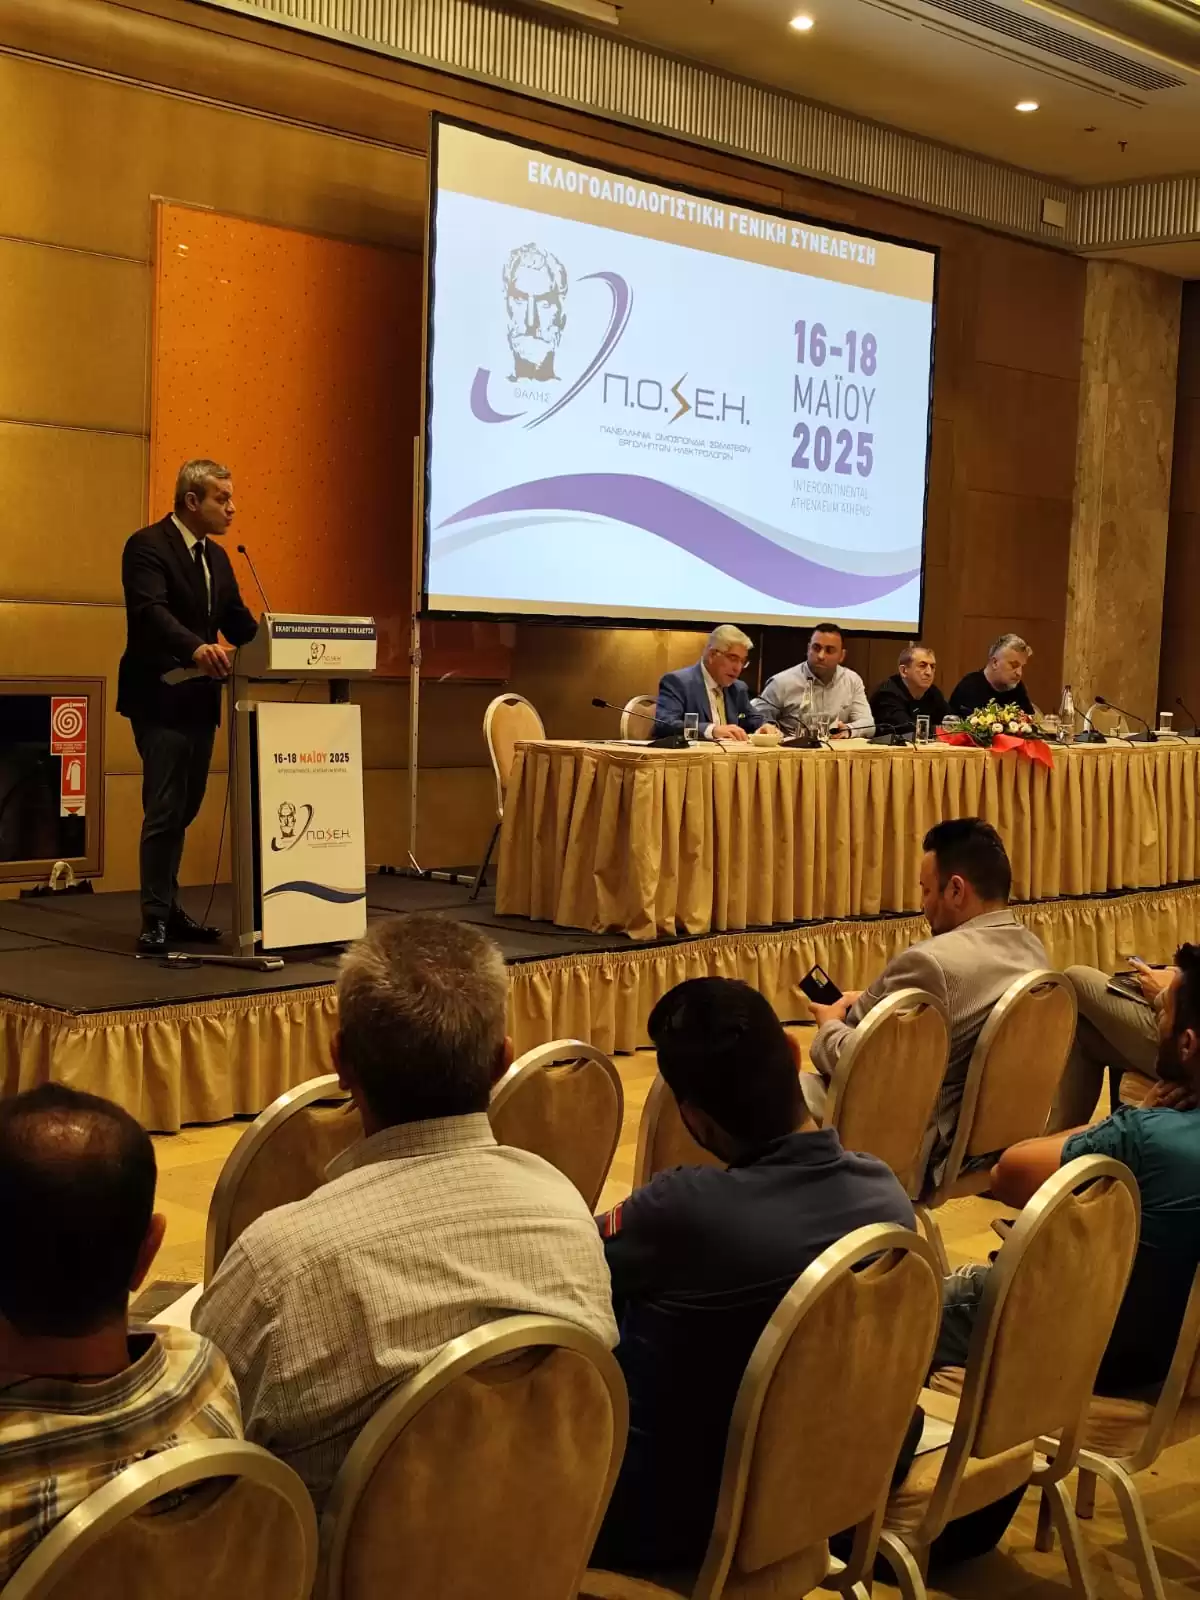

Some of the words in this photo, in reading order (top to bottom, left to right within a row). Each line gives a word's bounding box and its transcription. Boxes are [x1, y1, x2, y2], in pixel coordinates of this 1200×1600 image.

[527, 160, 725, 231] ΕΚΛΟΓΟΑΠΟΛΟΓΙΣΤΙΚΗ
[728, 212, 787, 245] ΓΕΝΙΚΗ
[790, 228, 876, 266] ΣΥΝΕΛΕΥΣΗ
[794, 319, 878, 377] 16-18
[513, 387, 552, 404] ΘΑΛΗΣ
[793, 374, 876, 425] ΜΑΪΟΥ
[791, 421, 874, 478] 2025
[274, 753, 297, 764] 16-18
[329, 752, 350, 763] 2025
